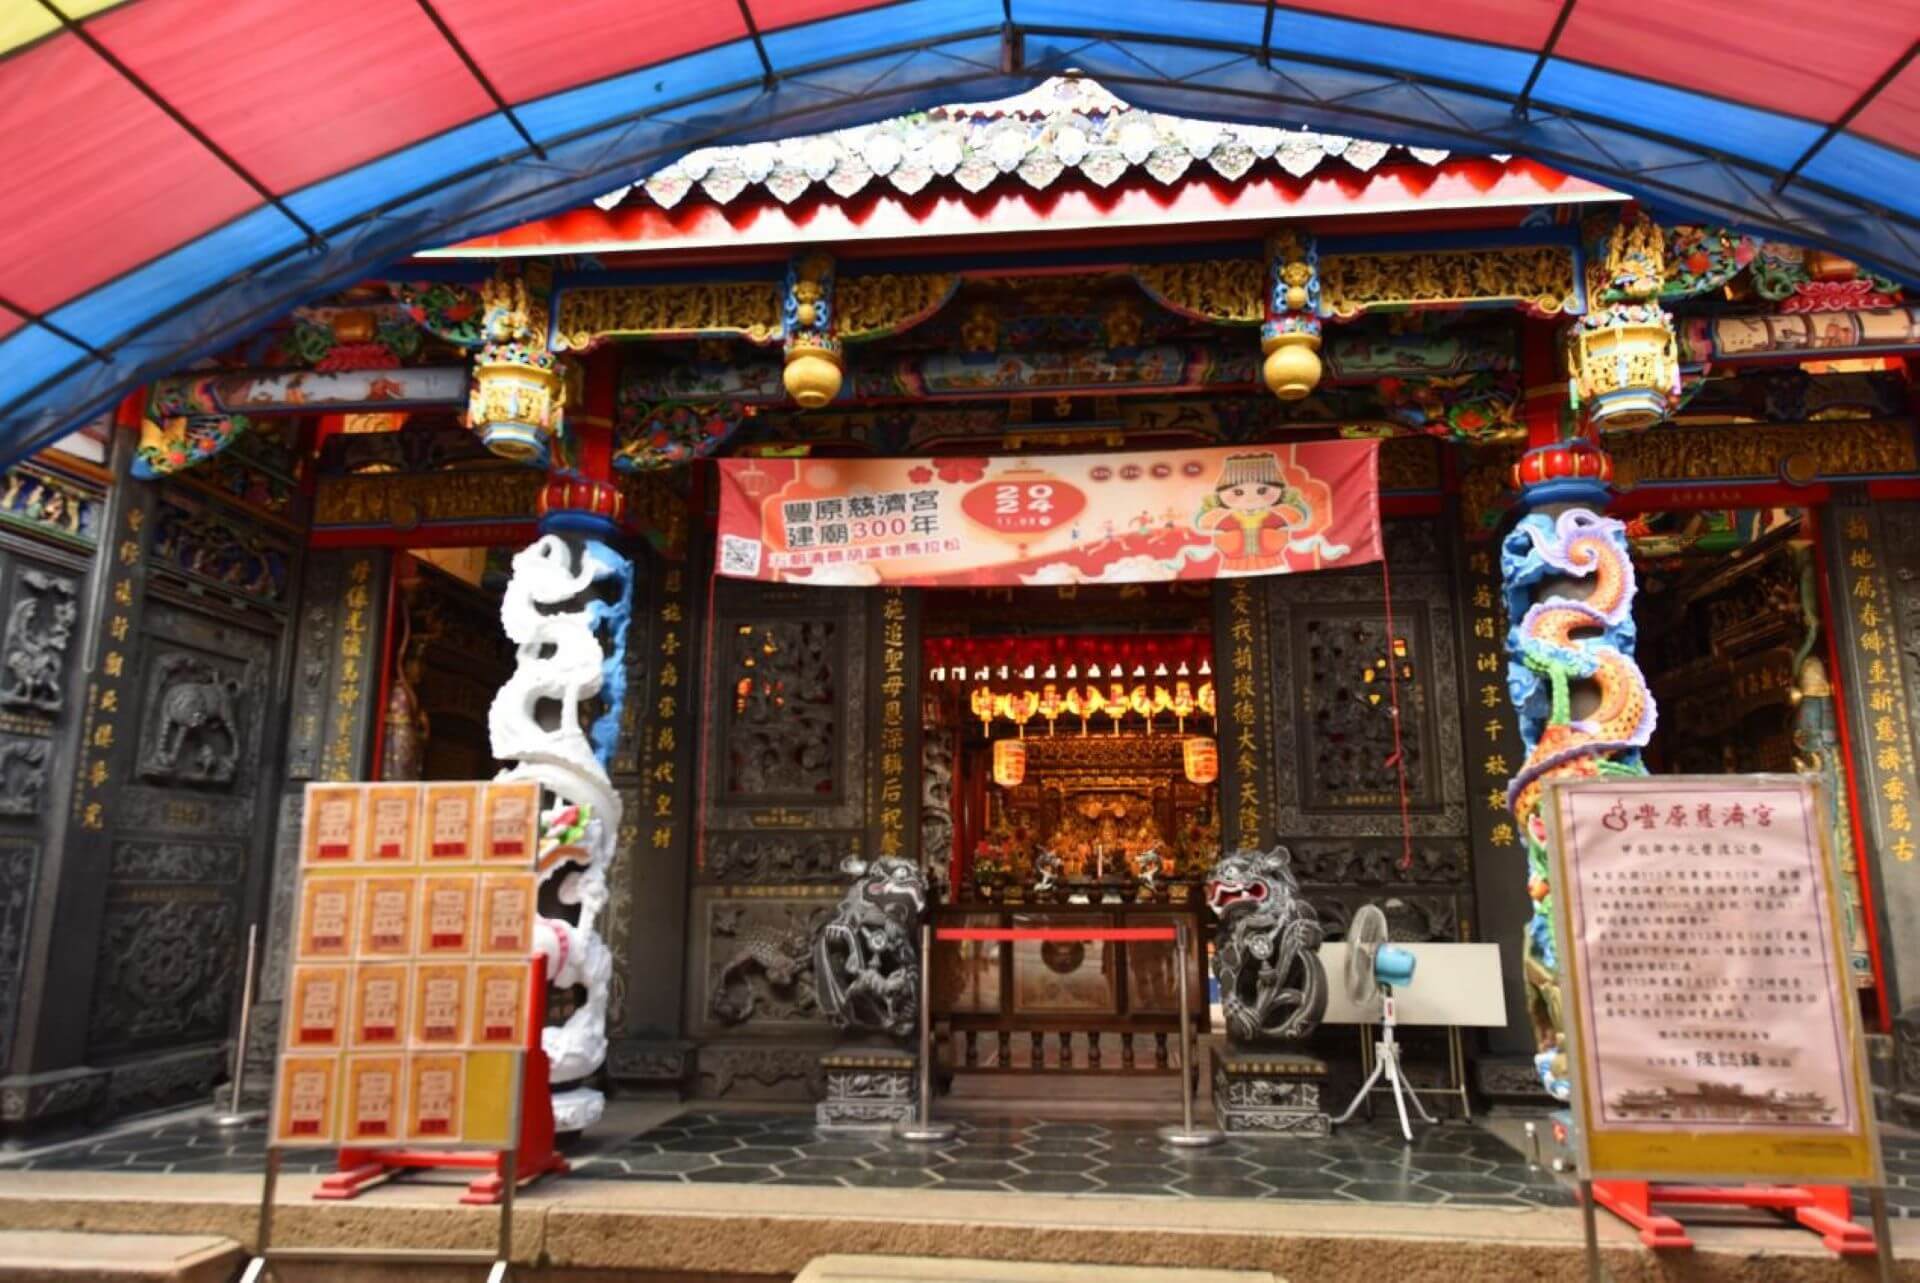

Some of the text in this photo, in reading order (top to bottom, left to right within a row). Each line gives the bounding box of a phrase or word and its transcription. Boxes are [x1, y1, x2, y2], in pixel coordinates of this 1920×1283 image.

[784, 490, 940, 524] 豐原慈濟宮
[788, 514, 939, 548] 建廟300年
[1634, 803, 1776, 829] 豐原慈濟宮
